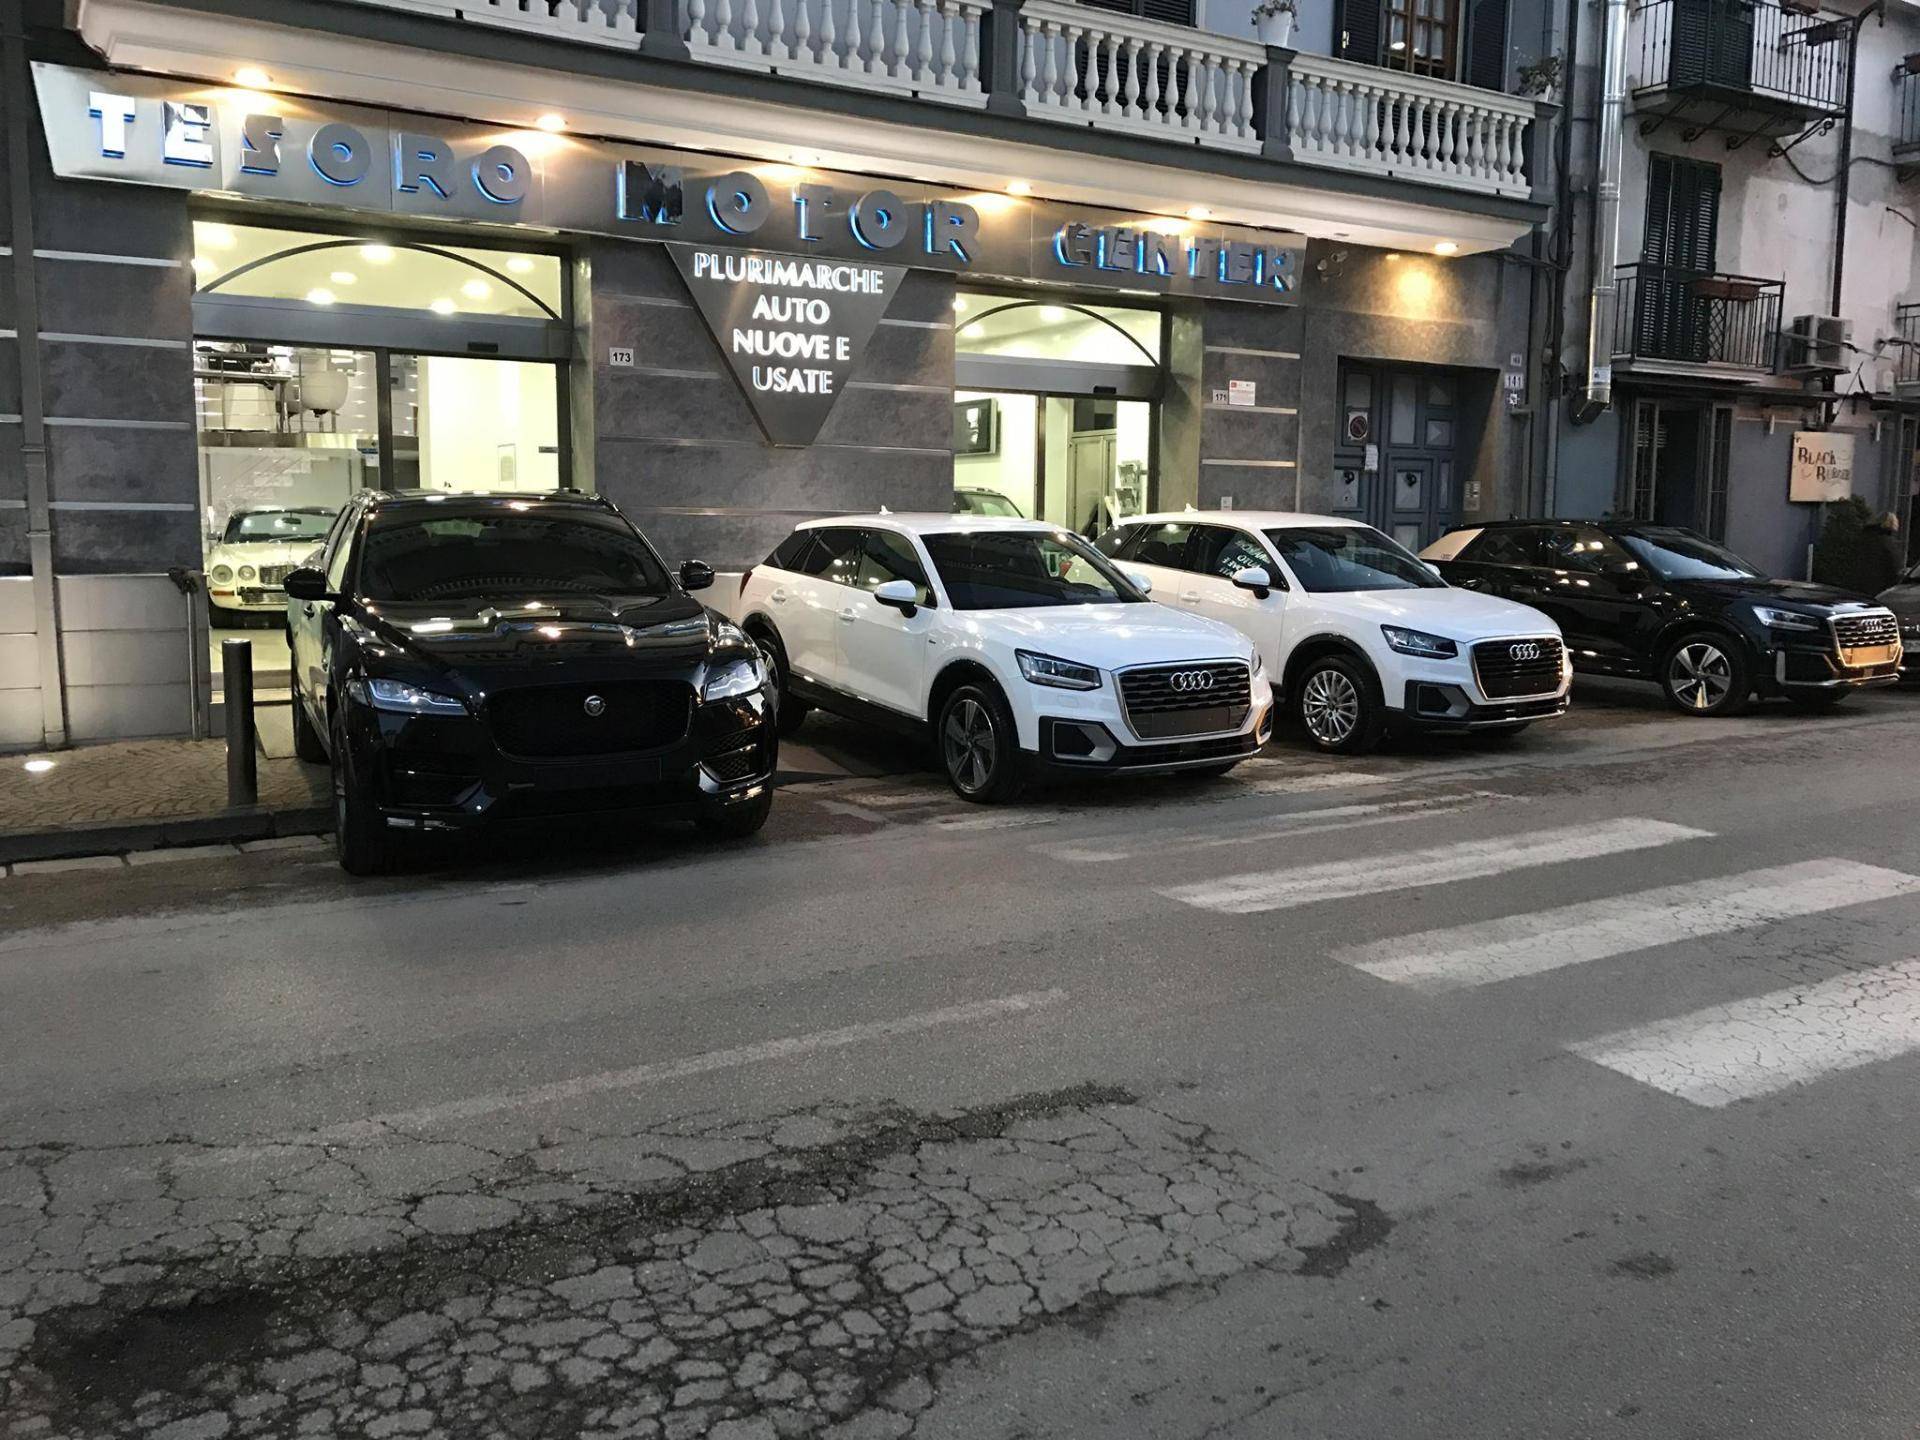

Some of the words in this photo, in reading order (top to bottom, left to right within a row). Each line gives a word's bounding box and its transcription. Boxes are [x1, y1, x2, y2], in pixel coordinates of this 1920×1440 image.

[89, 91, 533, 203] TESORO
[616, 160, 981, 265] MOTOR
[1053, 222, 1298, 292] CENTER
[694, 252, 884, 294] PLURIMARCHE
[752, 294, 831, 325] AUTO
[612, 351, 632, 363] 173
[733, 328, 830, 360] NUOVE
[836, 336, 850, 361] E
[752, 366, 833, 394] USATE
